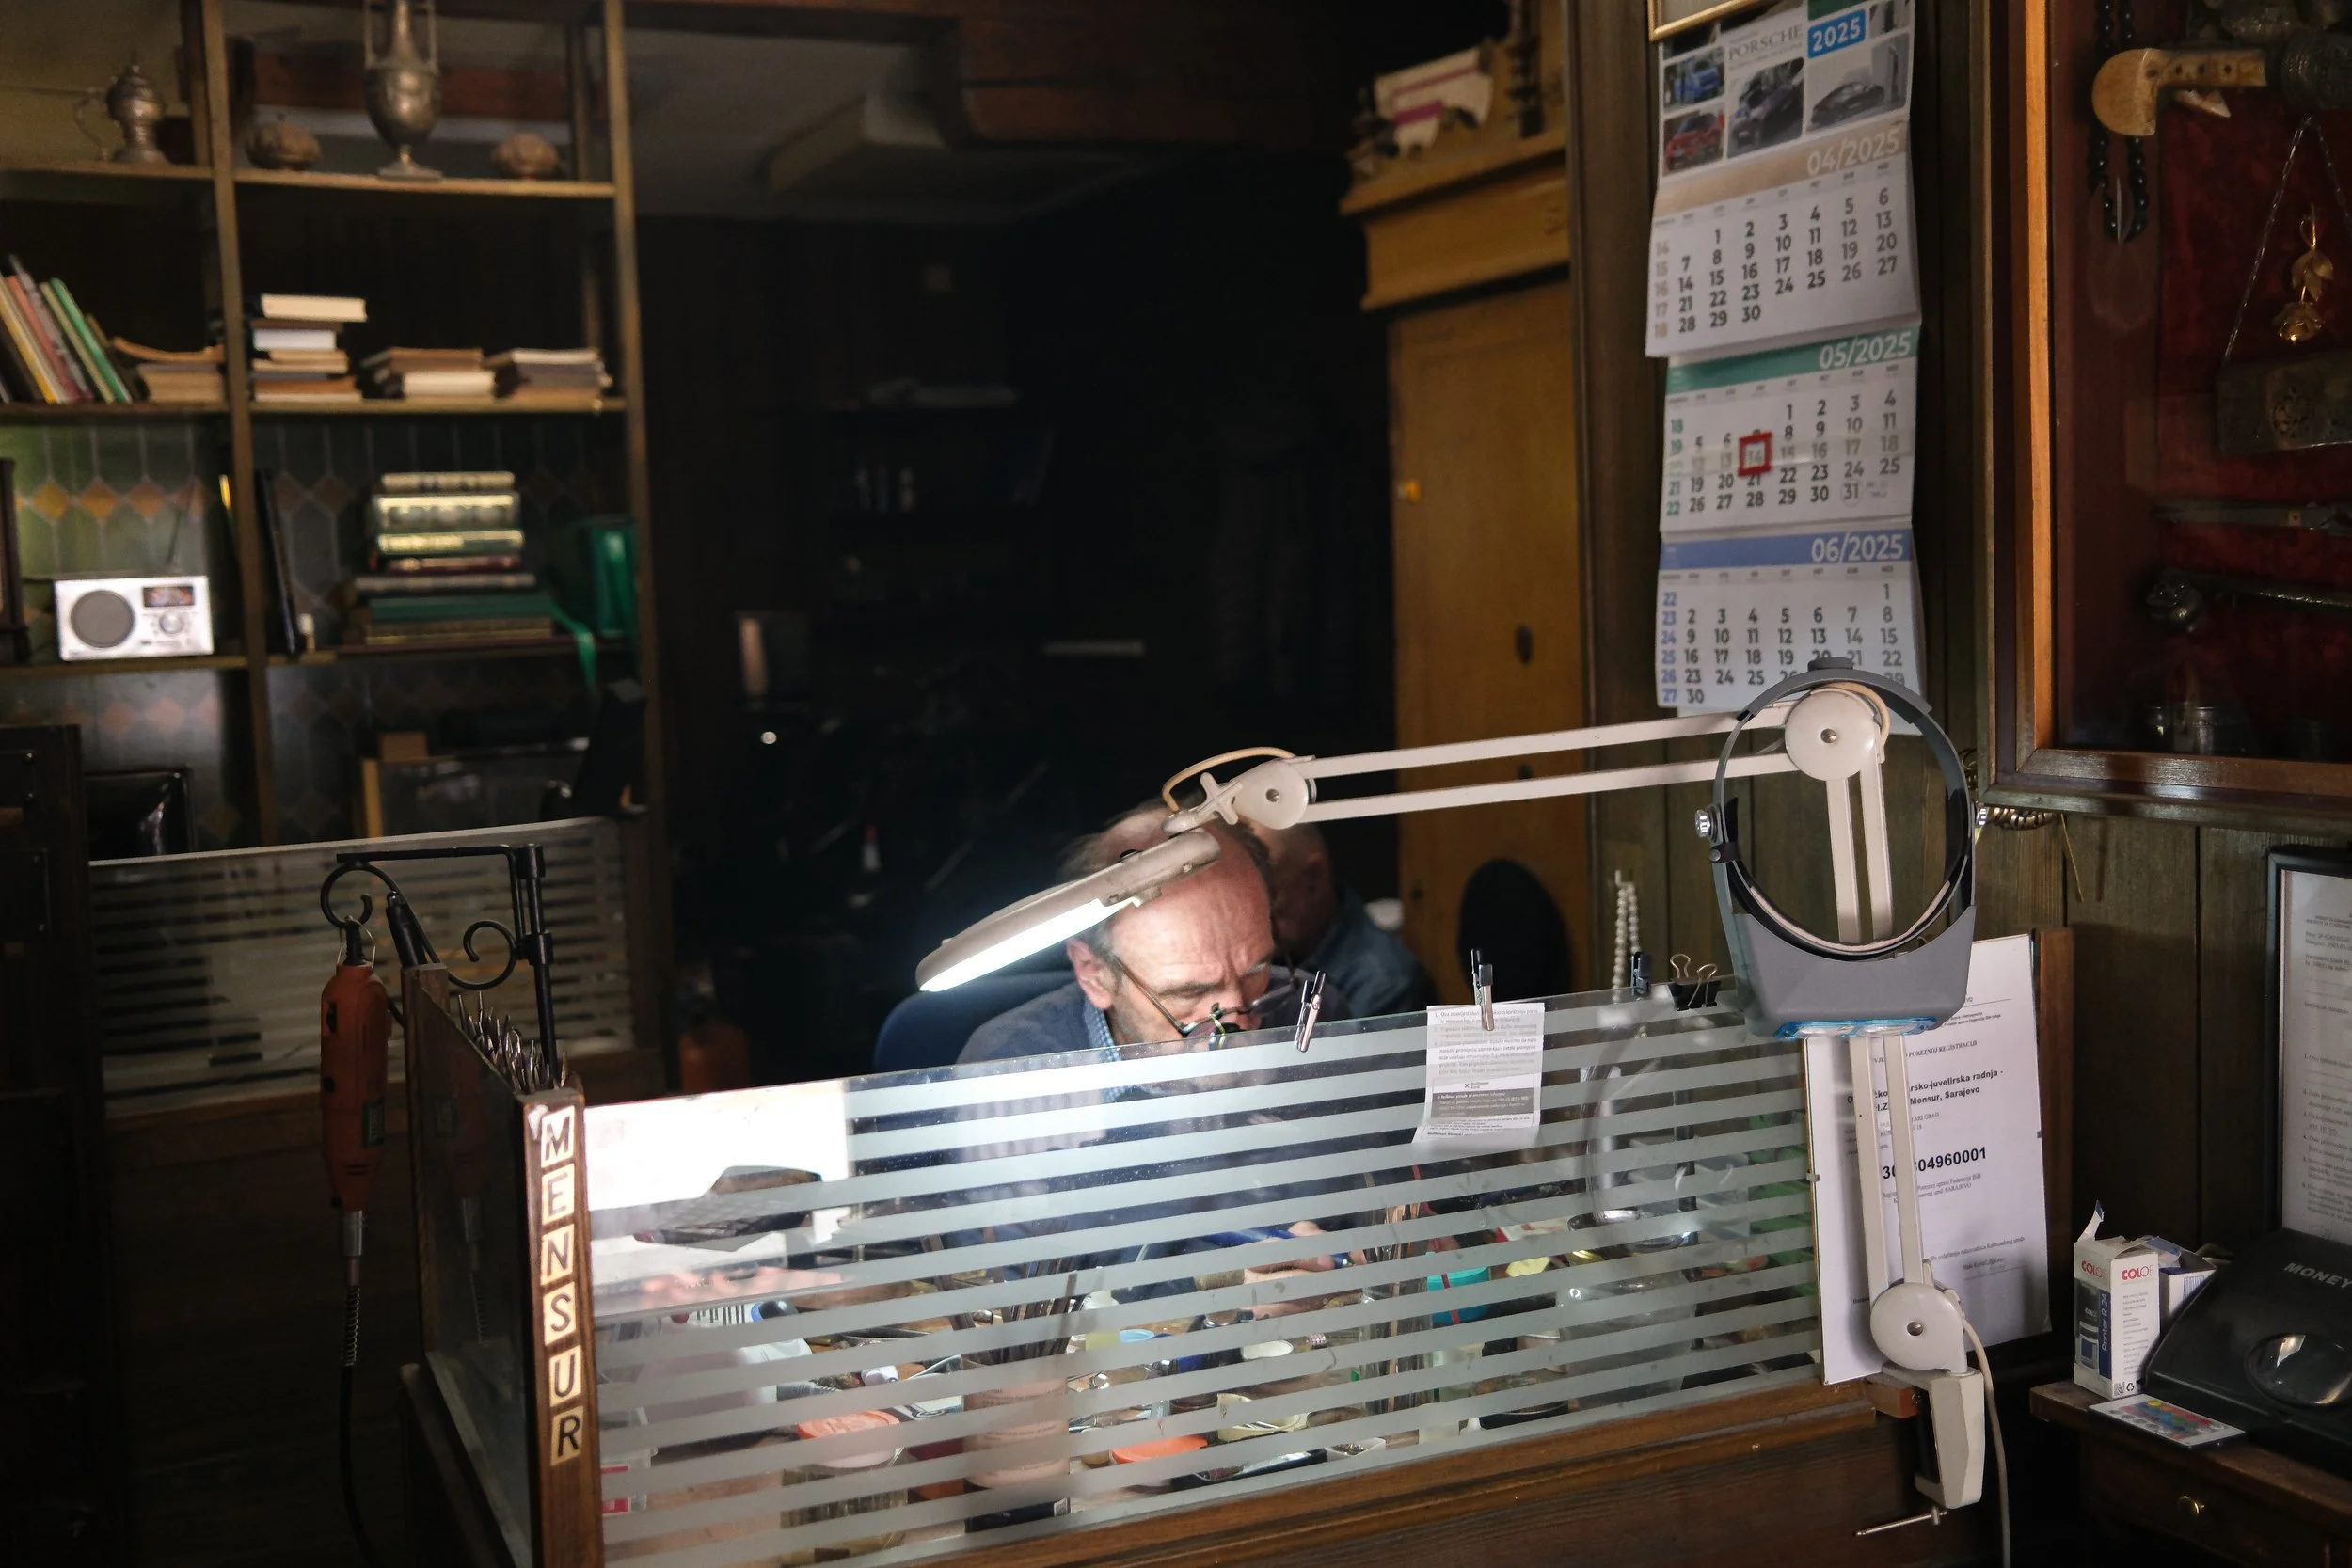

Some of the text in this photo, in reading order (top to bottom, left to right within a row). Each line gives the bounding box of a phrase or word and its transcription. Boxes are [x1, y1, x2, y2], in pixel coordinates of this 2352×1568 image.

[1728, 24, 1804, 61] PORSCHE
[1812, 16, 1861, 52] 2025
[1806, 127, 1899, 176] 04/2025
[1715, 229, 1720, 244] 1
[1746, 222, 1754, 237] 2
[1779, 214, 1787, 230] 3
[1811, 206, 1820, 221] 4
[1846, 198, 1853, 214] 5
[1879, 188, 1888, 205] 6
[1682, 256, 1690, 270] 7
[1713, 250, 1721, 265] 8
[1745, 243, 1754, 258] 9
[1776, 236, 1791, 251] 10
[1810, 228, 1820, 244] 11
[1842, 220, 1857, 236] 12
[1876, 211, 1892, 228] 13
[1679, 278, 1693, 292] 14
[1710, 270, 1724, 286] 15
[1743, 264, 1757, 279] 16
[1776, 257, 1790, 273] 17
[1808, 250, 1823, 266] 18
[1842, 242, 1858, 258] 19
[1877, 234, 1896, 251] 20
[1679, 297, 1692, 311] 21
[1710, 291, 1726, 307] 22
[1742, 285, 1759, 301] 23
[1776, 279, 1793, 295] 24
[1807, 272, 1825, 289] 25
[1842, 263, 1860, 281] 26
[1878, 256, 1896, 275] 27
[1679, 318, 1695, 333] 28
[1710, 312, 1727, 327] 29
[1742, 306, 1760, 322] 30
[1819, 332, 1912, 369] 05/2025
[1787, 404, 1792, 420] 1
[1818, 400, 1826, 416] 2
[1851, 396, 1859, 411] 3
[1885, 390, 1895, 406] 4
[1785, 426, 1793, 440] 8
[1816, 421, 1824, 437] 9
[1847, 417, 1862, 433] 10
[1883, 413, 1896, 429] 11
[1846, 439, 1859, 455] 17
[1881, 435, 1898, 452] 18
[1691, 476, 1703, 492] 19
[1718, 474, 1733, 489] 20
[1780, 468, 1796, 484] 22
[1811, 465, 1828, 482] 23
[1845, 461, 1864, 479] 24
[1880, 459, 1900, 475] 25
[1689, 496, 1705, 512] 26
[1716, 493, 1732, 510] 27
[1746, 491, 1764, 508] 28
[1779, 488, 1796, 505] 29
[1811, 486, 1829, 503] 30
[1843, 483, 1859, 500] 31
[1811, 533, 1903, 563] 06/2025
[1883, 584, 1889, 600] 1
[1688, 608, 1695, 624] 2
[1718, 608, 1726, 623] 3
[1748, 607, 1757, 623] 4
[1781, 607, 1789, 623] 5
[1813, 607, 1823, 623] 6
[1847, 606, 1857, 621] 7
[1883, 606, 1892, 622] 8
[1687, 629, 1695, 644] 9
[1715, 629, 1729, 644] 10
[1747, 628, 1759, 644] 11
[1778, 628, 1792, 644] 12
[1811, 628, 1826, 644] 13
[1845, 628, 1863, 644] 14
[1880, 628, 1897, 644] 15
[1684, 649, 1699, 665] 16
[1715, 649, 1728, 665] 17
[1746, 649, 1761, 665] 18
[1778, 649, 1793, 665] 19
[1882, 650, 1902, 666] 22
[1685, 670, 1701, 685] 23
[1716, 670, 1733, 685] 24
[1748, 670, 1764, 686] 25
[1687, 689, 1704, 704] 30
[1908, 1046, 1938, 1058] POREZNOJ
[1909, 1075, 1971, 1092] rsko-juvelirska
[1972, 1069, 1998, 1082] radnja
[1910, 1086, 1980, 1106] Mensur, Sarajevo
[2081, 1260, 2107, 1278] COLOP
[2121, 1264, 2154, 1280] COLOP
[2283, 1262, 2352, 1289] MONEY
[544, 1115, 581, 1458] MENSUR
[2101, 1293, 2108, 1305] 24
